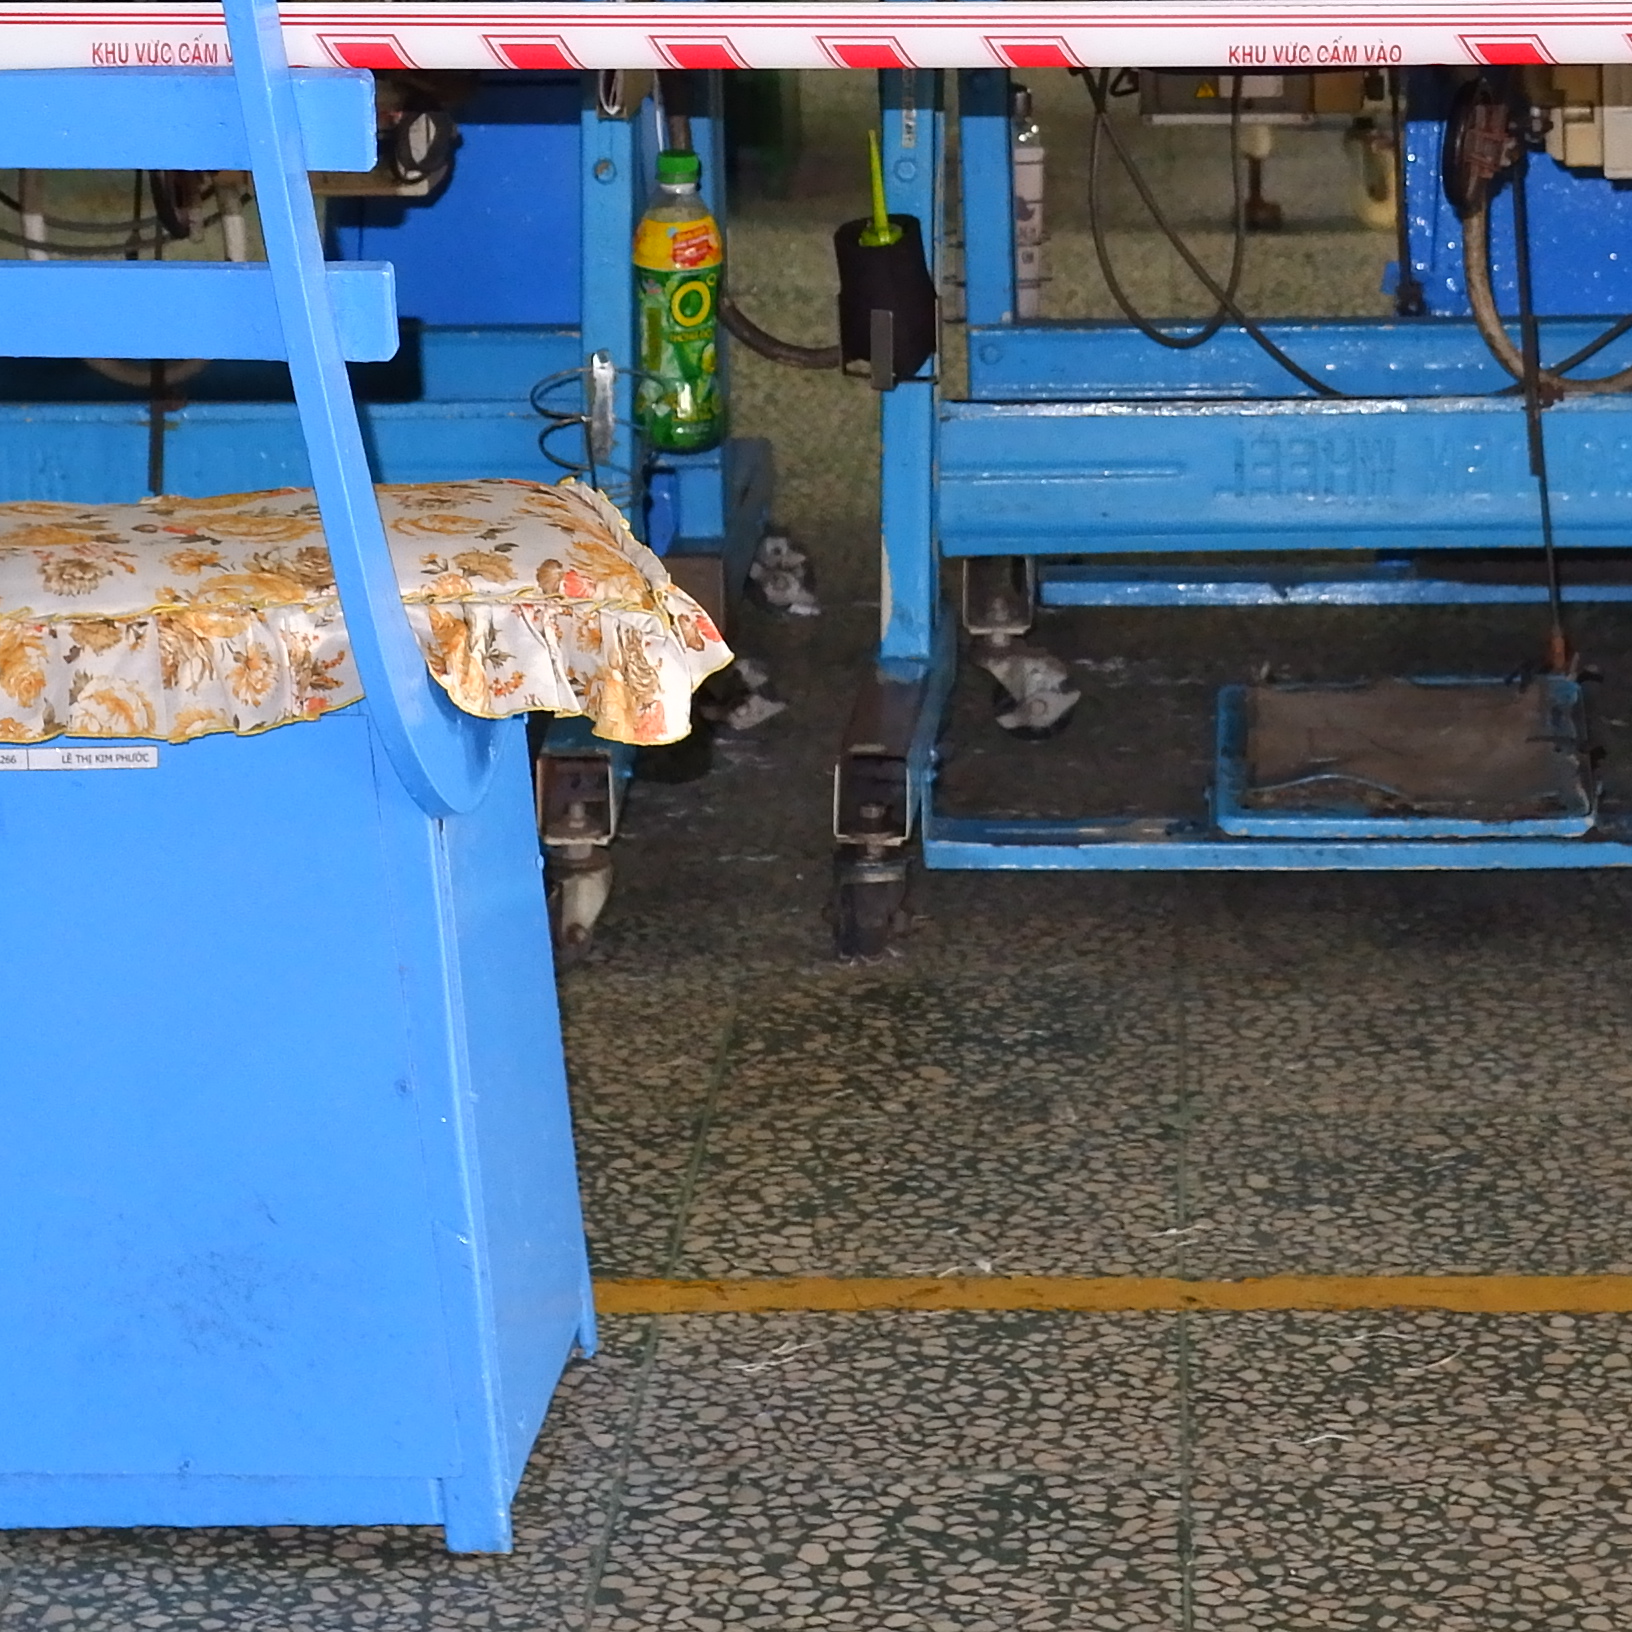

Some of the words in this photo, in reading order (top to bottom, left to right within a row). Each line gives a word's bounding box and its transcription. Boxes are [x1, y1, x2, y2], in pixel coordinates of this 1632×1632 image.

[92, 43, 129, 64] KHU
[178, 34, 218, 64] CẤM
[1229, 45, 1266, 64] KHU
[1317, 36, 1357, 63] CẤM
[1364, 39, 1403, 63] VÀO
[95, 754, 114, 764] KIM
